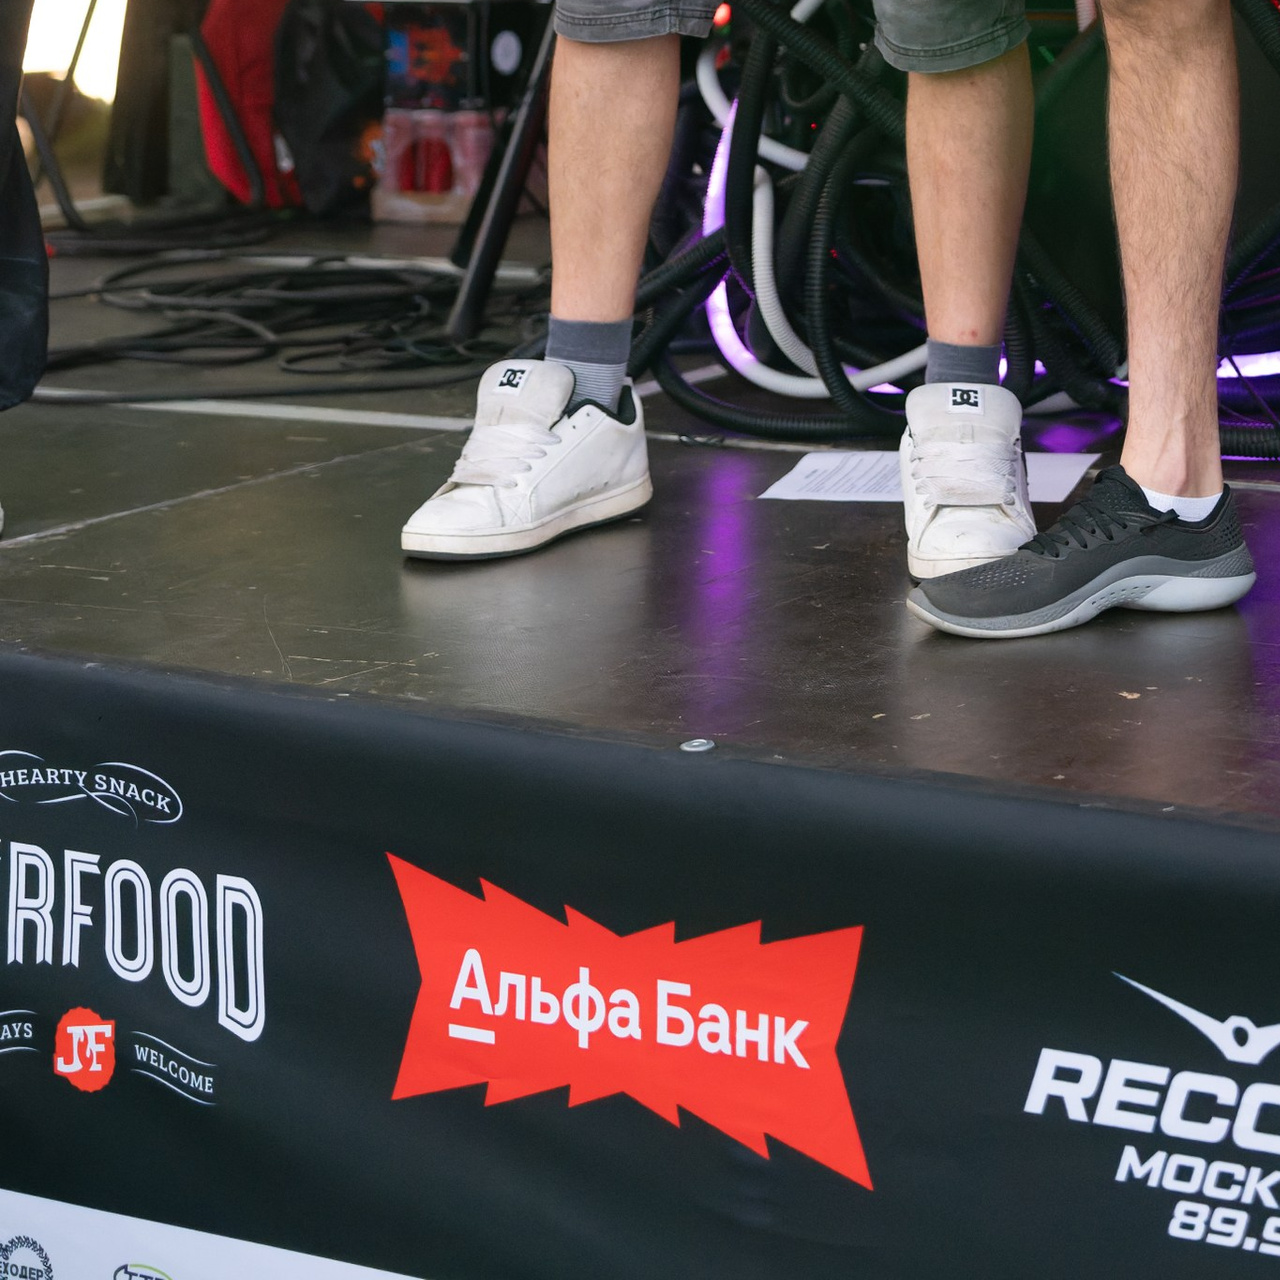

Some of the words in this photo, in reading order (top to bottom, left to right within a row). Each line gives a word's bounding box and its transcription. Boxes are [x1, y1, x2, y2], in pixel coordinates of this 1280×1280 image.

[0, 767, 88, 788] HEARTY
[95, 773, 171, 814] SNACK
[0, 840, 266, 1043] RFOOD
[449, 947, 642, 1049] Альфа
[656, 978, 811, 1071] Банк
[134, 1044, 214, 1094] WELCOME
